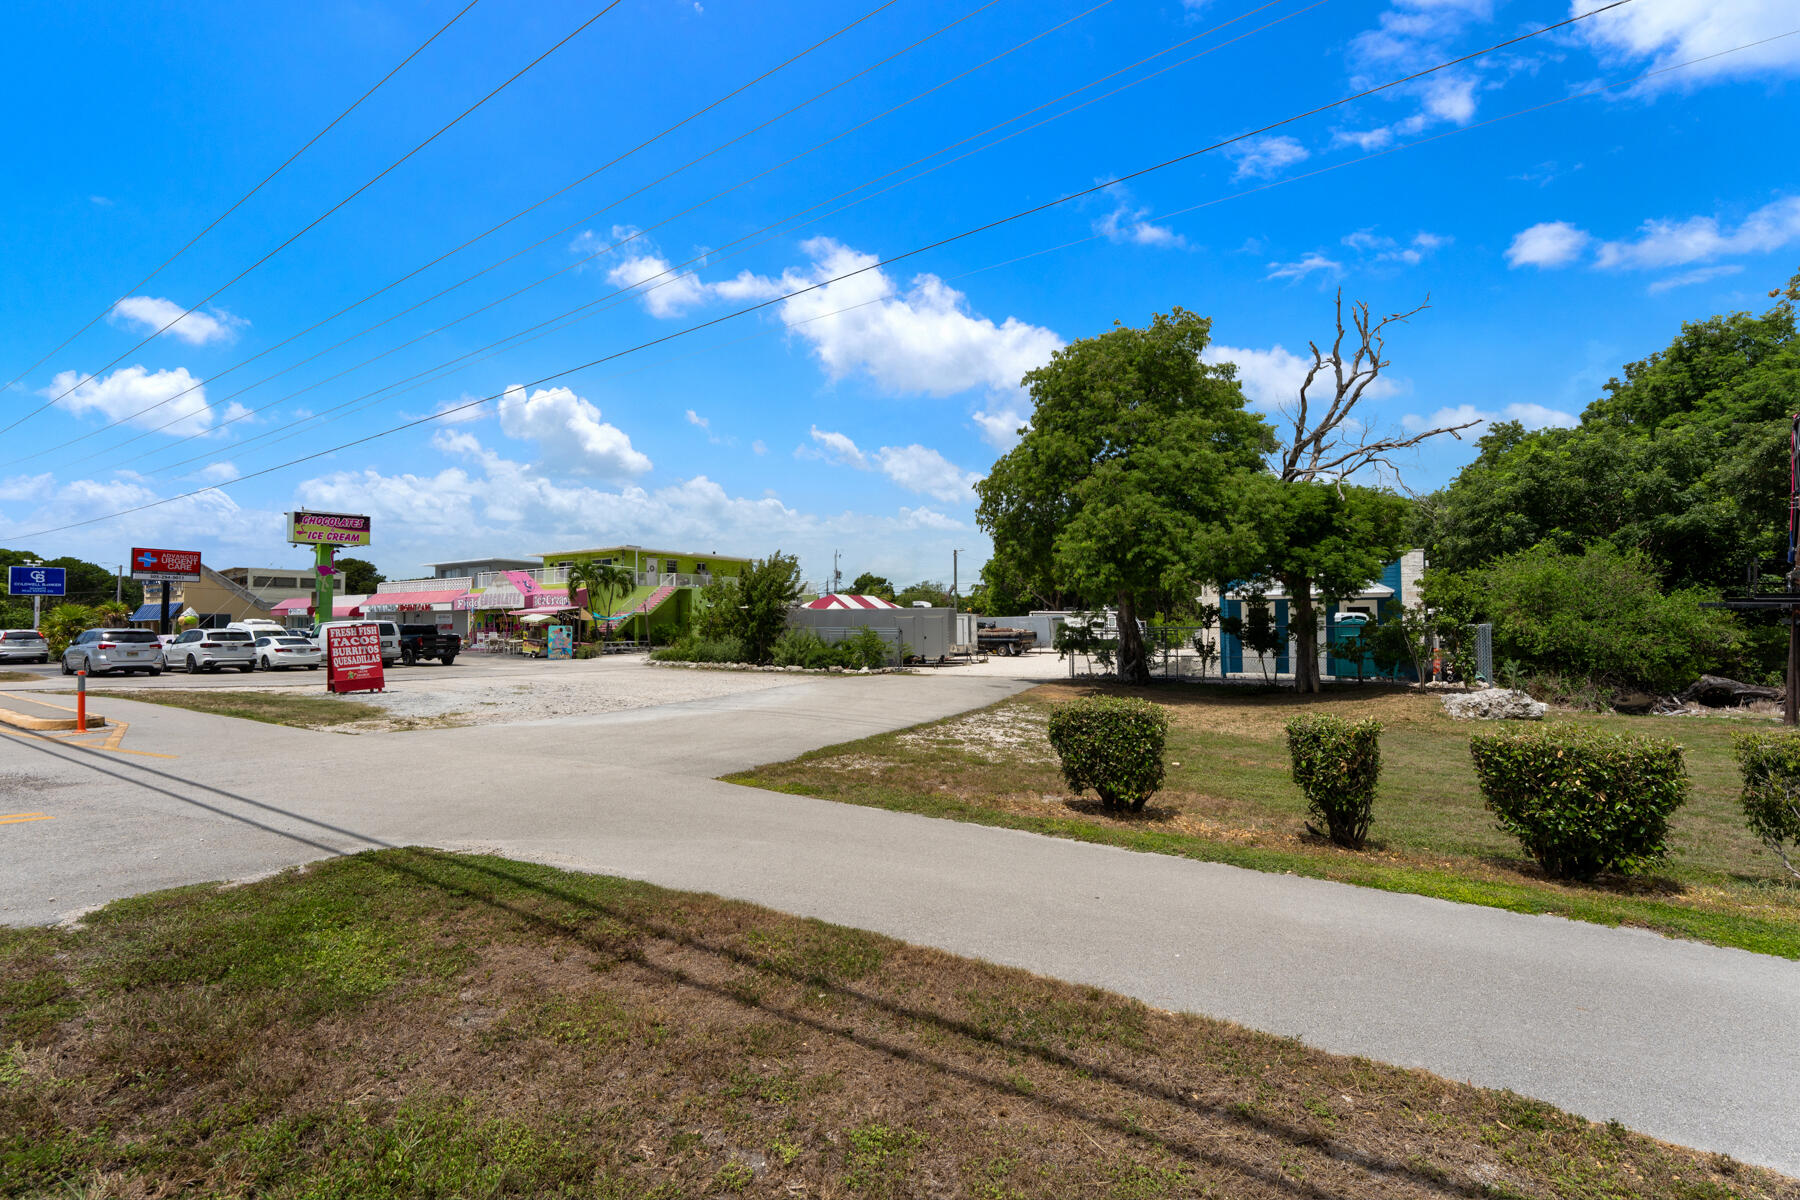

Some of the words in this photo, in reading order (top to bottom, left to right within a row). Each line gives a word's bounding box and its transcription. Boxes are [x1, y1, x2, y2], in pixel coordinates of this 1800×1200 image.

[302, 516, 364, 528] CHOCOLATES
[307, 531, 324, 540] ICE
[326, 532, 360, 542] CREAM
[167, 563, 192, 571] CARE
[330, 627, 357, 638] FRESH
[358, 626, 378, 636] FISH
[330, 635, 379, 647] TACOS
[332, 645, 380, 657] BURRITOS
[333, 654, 381, 668] QUESADILLAS
